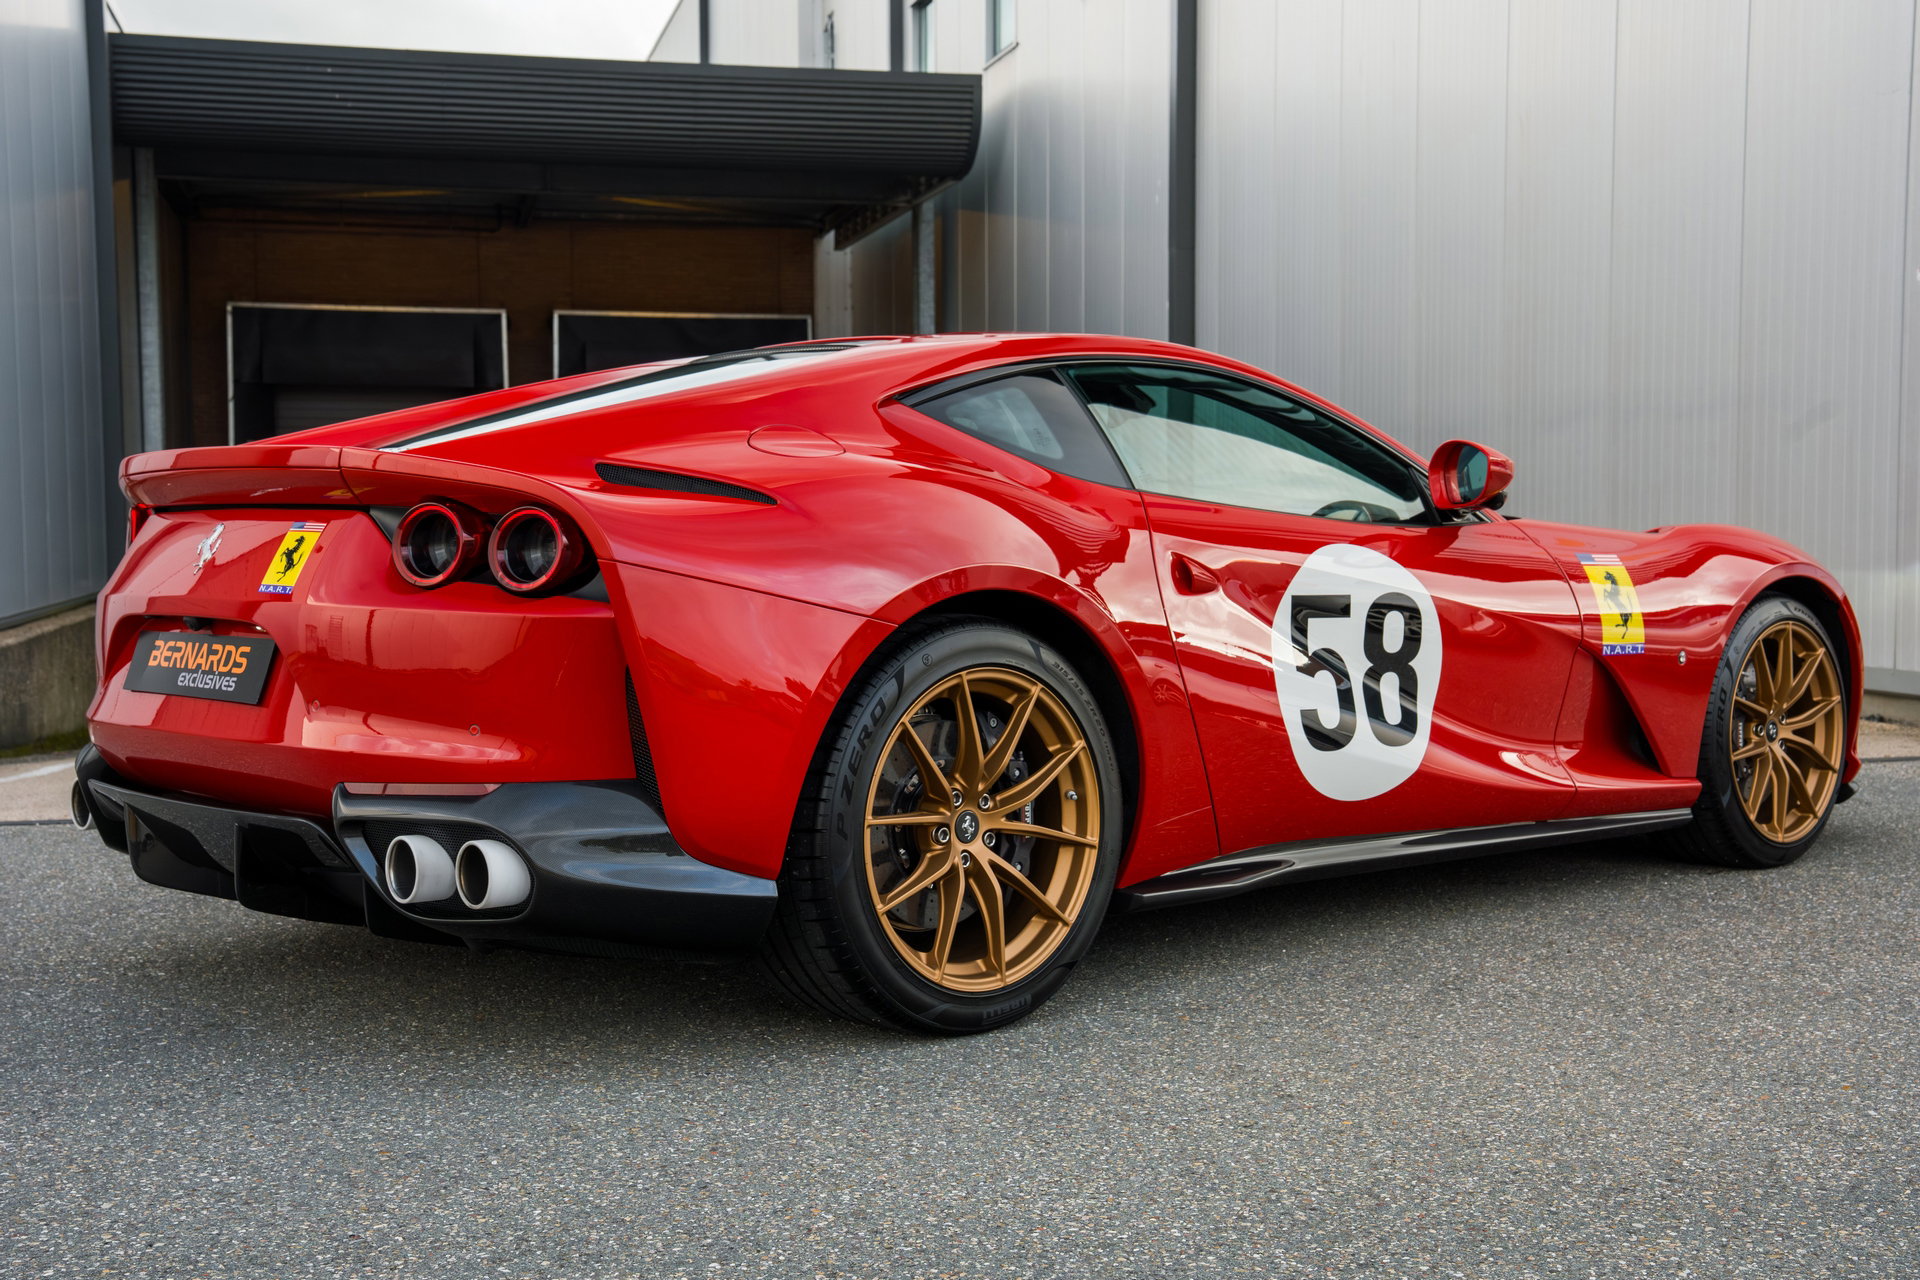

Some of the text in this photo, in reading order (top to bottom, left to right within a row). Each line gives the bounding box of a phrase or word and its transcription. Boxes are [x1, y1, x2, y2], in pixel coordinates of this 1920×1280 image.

[259, 584, 292, 594] N.A.R.T.
[148, 640, 251, 674] BERNARDS
[1602, 644, 1644, 655] N.A.R.T.
[178, 670, 237, 691] exclusives
[1291, 592, 1422, 751] 58
[837, 697, 887, 841] P ZERO
